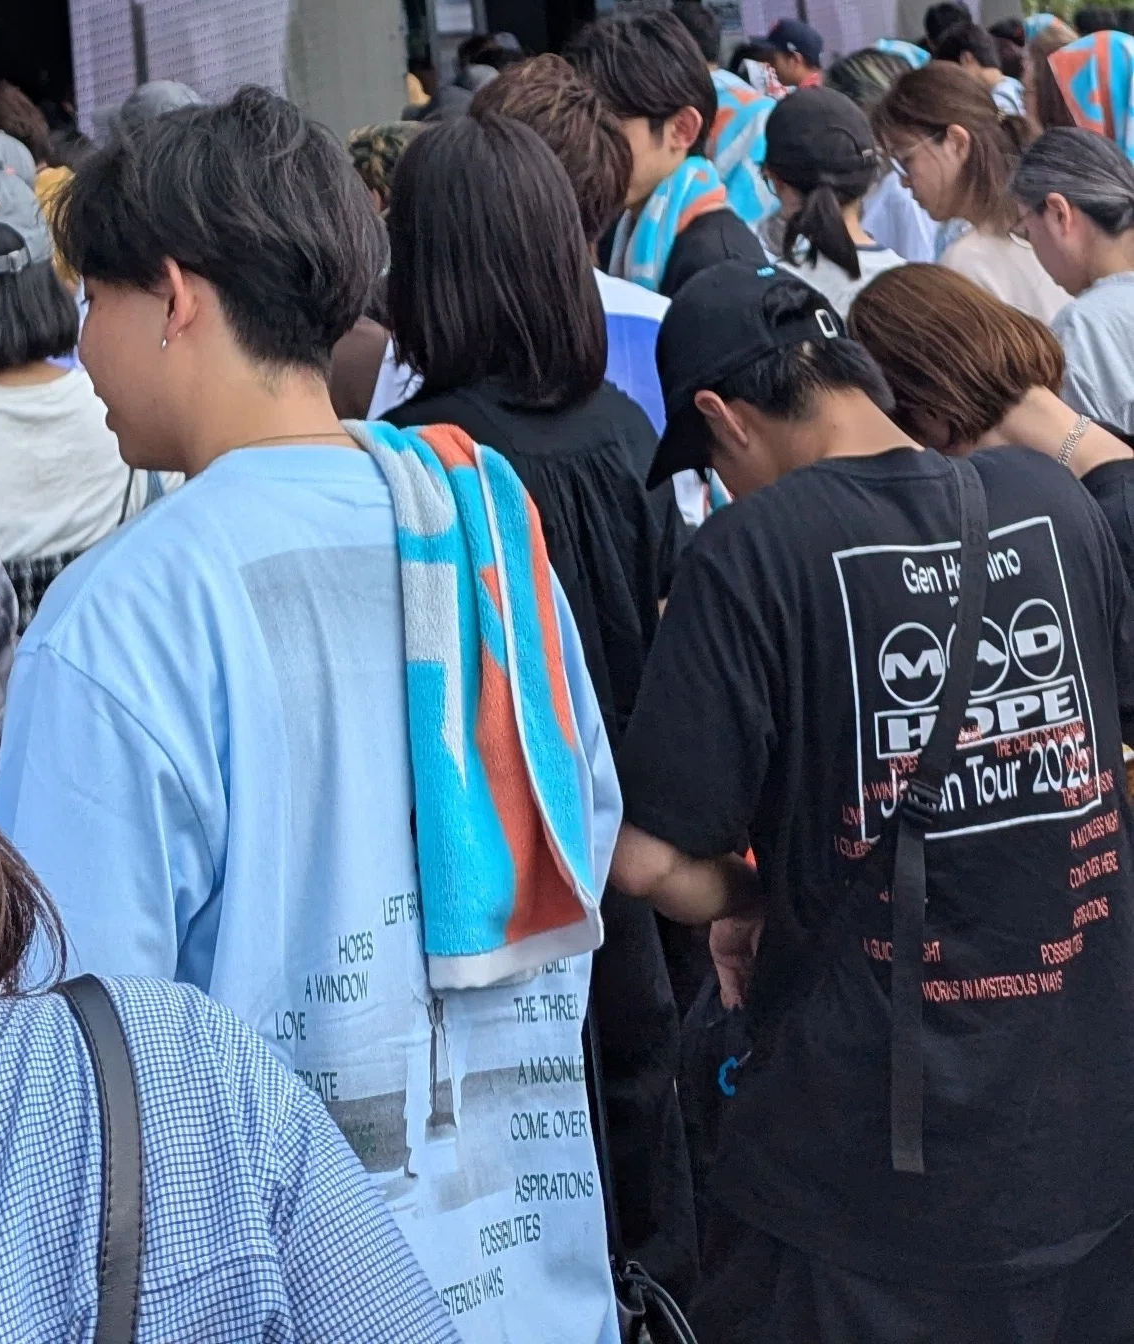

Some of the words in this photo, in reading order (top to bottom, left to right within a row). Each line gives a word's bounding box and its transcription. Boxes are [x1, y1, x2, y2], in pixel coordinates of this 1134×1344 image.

[902, 557, 943, 594] Gen
[941, 548, 1022, 592] Hino
[966, 754, 1021, 806] Tour
[1028, 732, 1091, 794] 2025
[382, 894, 405, 925] LEFT
[338, 930, 374, 964] HOPES
[304, 973, 313, 1004] A
[314, 970, 369, 1004] WINDOW
[922, 979, 960, 1002] WORKS
[961, 979, 974, 1000] IN
[974, 973, 1038, 999] MYSTERIOUS
[1038, 969, 1063, 993] WAYS
[513, 995, 539, 1024] THE
[539, 992, 580, 1023] THREE
[274, 1010, 307, 1041] LOVE
[517, 1058, 528, 1086] A
[529, 1054, 585, 1085] MOONLE
[509, 1111, 551, 1142] COME
[552, 1109, 589, 1139] OVER
[514, 1170, 595, 1204] ASPIRATIONS
[479, 1212, 542, 1259] POSSIBILITIES
[434, 1273, 482, 1317] YSTERIOUS
[480, 1265, 505, 1303] WAYS
